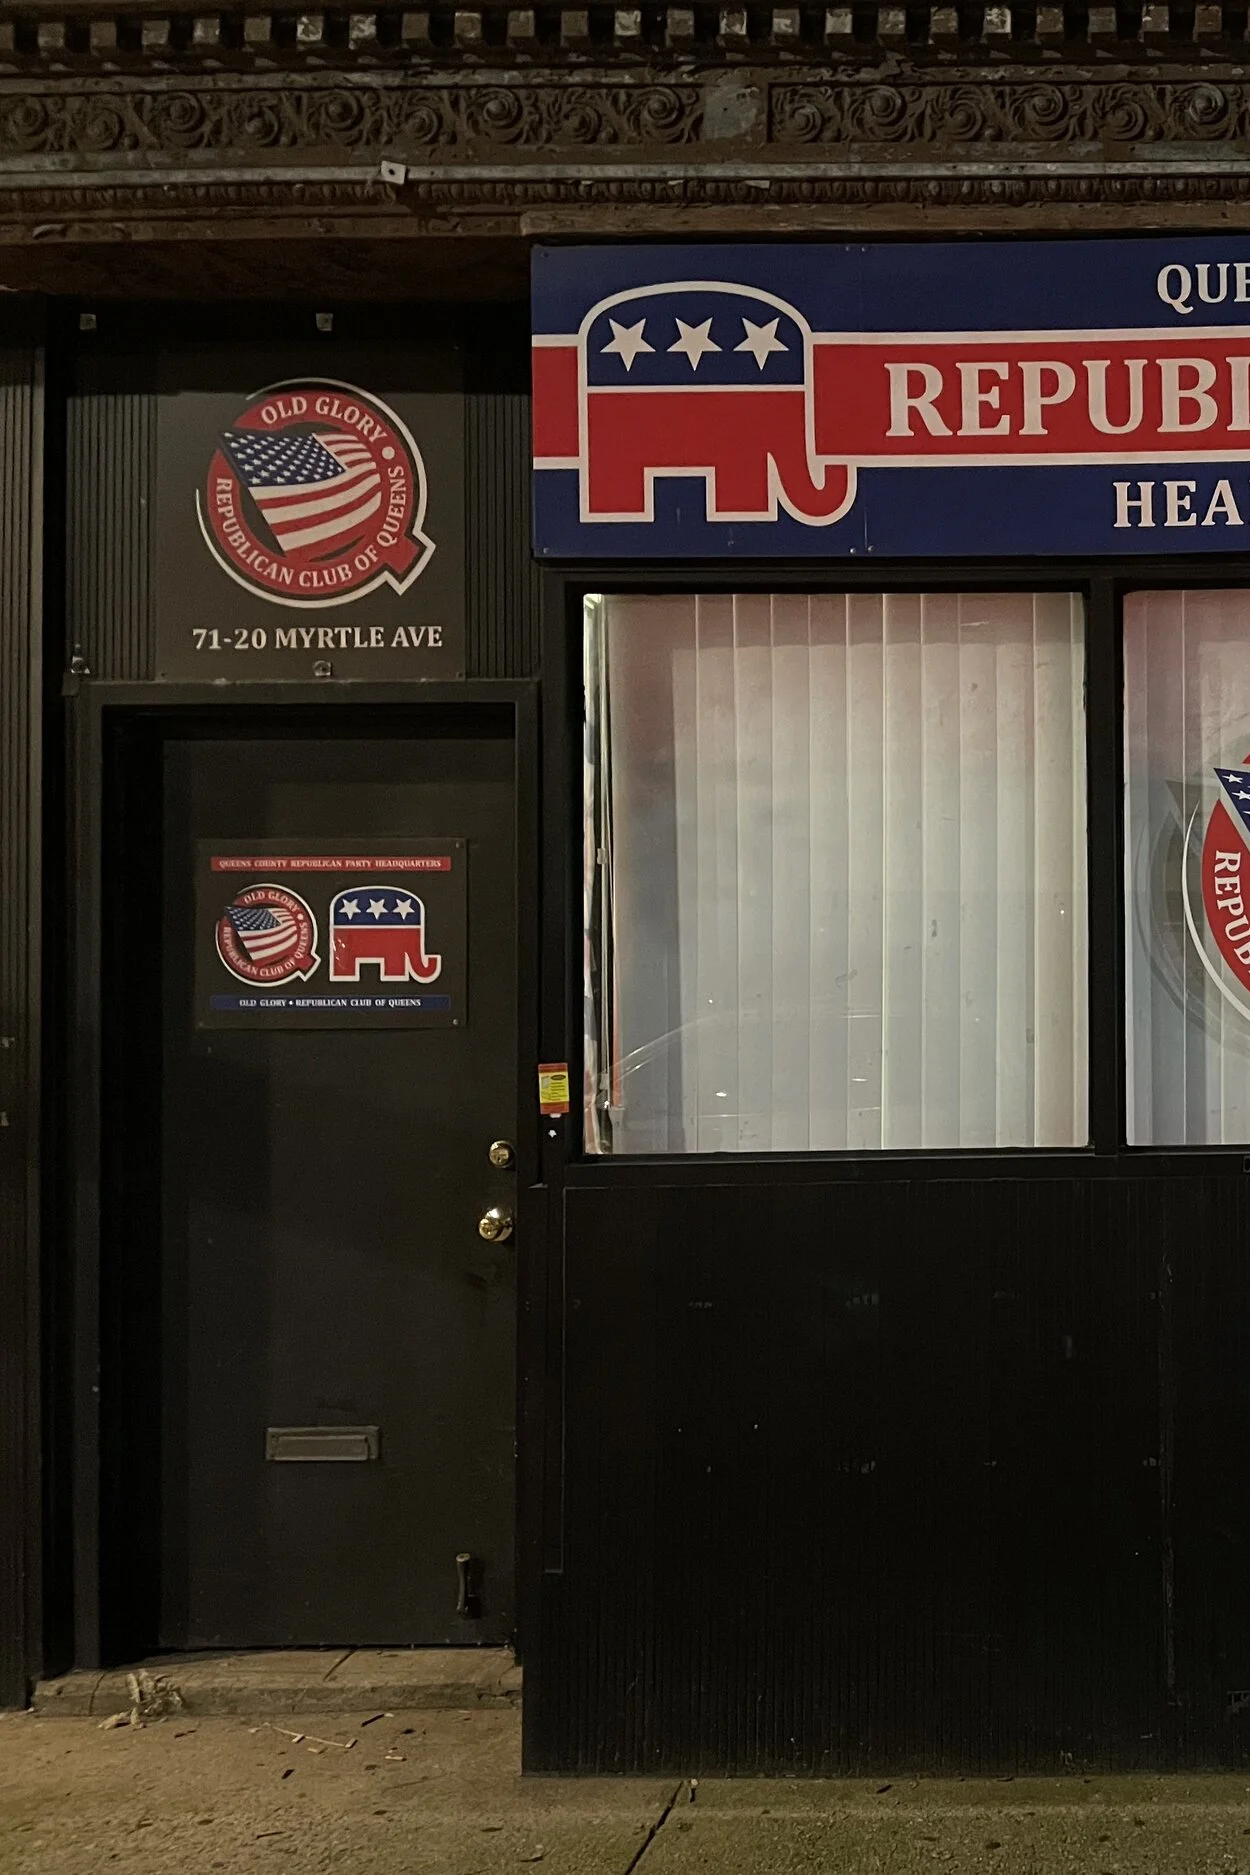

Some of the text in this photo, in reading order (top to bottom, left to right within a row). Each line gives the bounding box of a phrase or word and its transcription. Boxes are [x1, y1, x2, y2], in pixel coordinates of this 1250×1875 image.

[260, 396, 388, 442] OLD GLORY
[216, 465, 407, 588] REPUBLICAN CLUB OF QUEENS
[192, 625, 443, 651] 71-20 MYRTLE AVE
[219, 859, 442, 868] QUEENS COUNTY REPUBLICAN PARTY HEADQUARTERS
[244, 891, 299, 912] OLD GLORY
[239, 999, 422, 1008] OLD GLORY REPUBLICAN CLUB OF QUEENS
